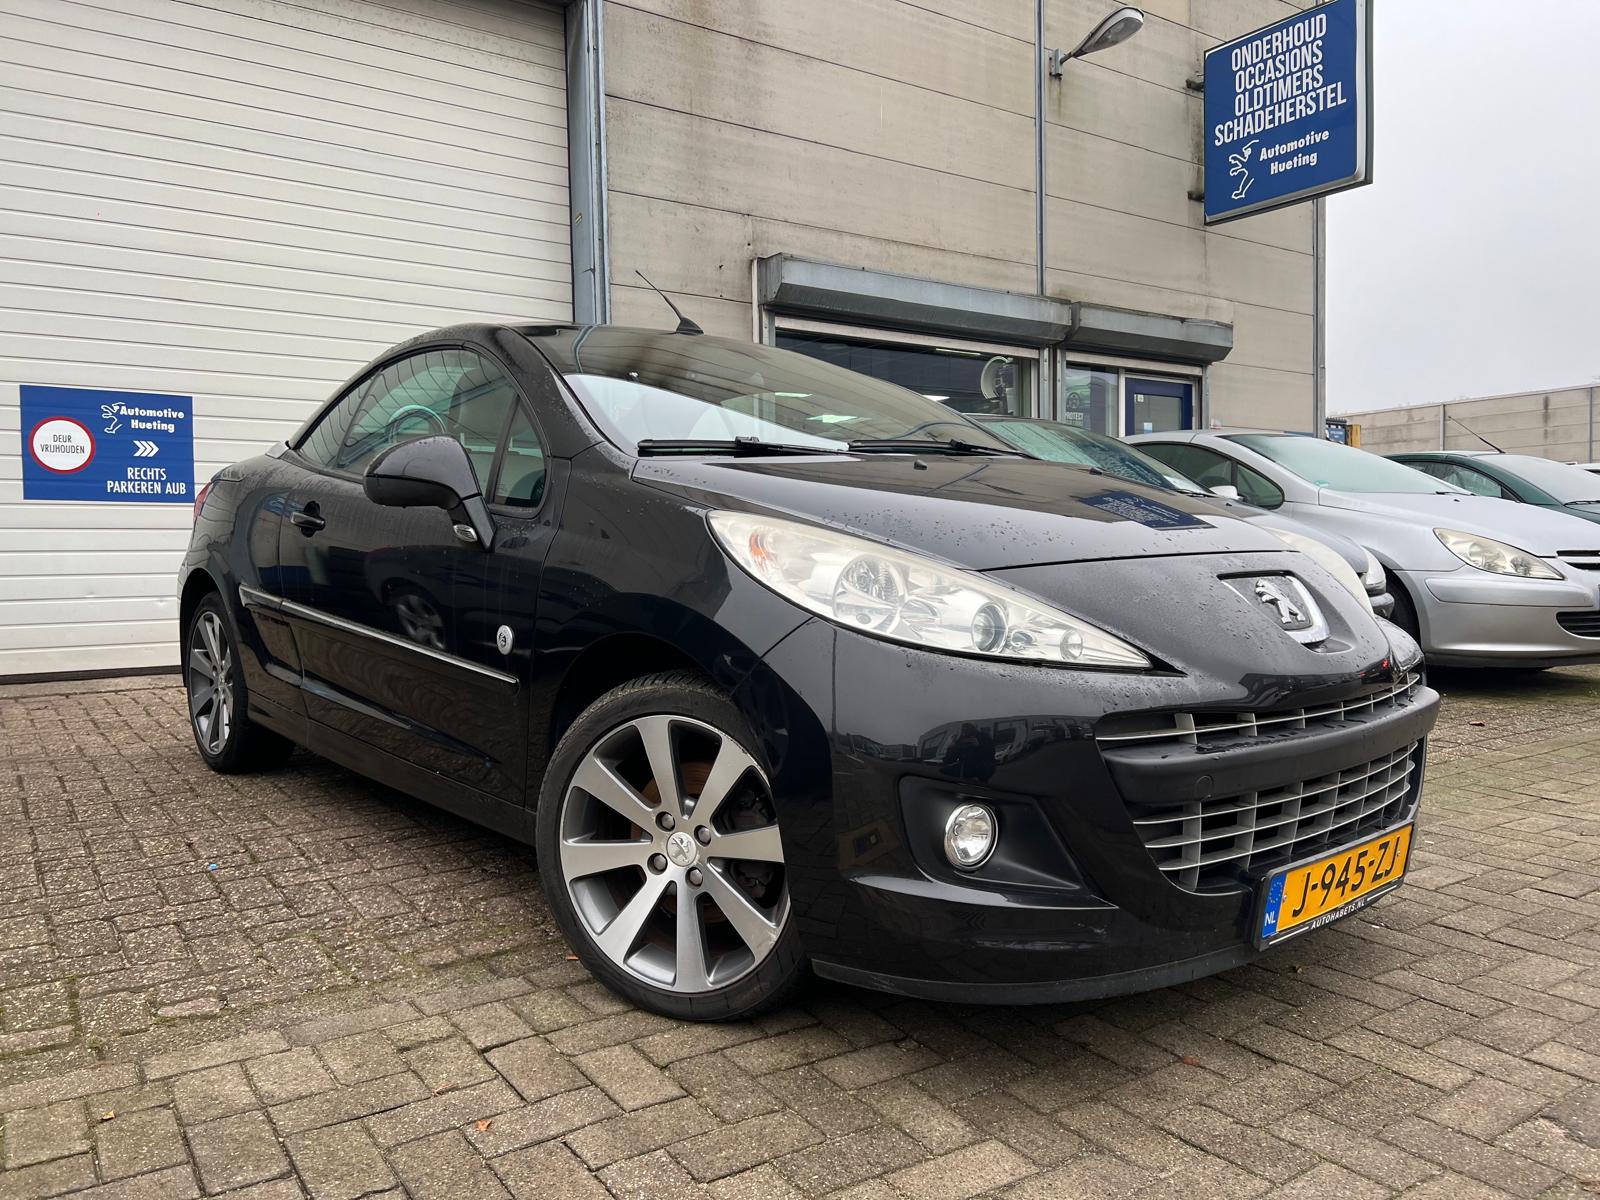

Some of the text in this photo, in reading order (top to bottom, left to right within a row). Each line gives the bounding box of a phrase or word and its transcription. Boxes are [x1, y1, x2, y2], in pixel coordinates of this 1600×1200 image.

[1231, 13, 1327, 72] ONDERHOUD
[1235, 39, 1323, 93] OCCASIONS
[1234, 64, 1324, 117] OLDTIMERS
[1214, 81, 1347, 147] SCHADEHERSTEL
[1259, 130, 1330, 161] Automotive
[1270, 152, 1318, 175] Hueting
[120, 405, 185, 419] Automotive
[131, 419, 175, 433] Hueting
[40, 444, 85, 454] VRIJHOUDEN
[53, 434, 72, 443] DEUR
[127, 467, 167, 481] RECHTS
[107, 480, 187, 495] PARKEREN AUB
[1292, 836, 1400, 917] J-945-ZJ
[1264, 911, 1276, 926] NL
[1311, 898, 1365, 930] AUTOHABETS.NL
